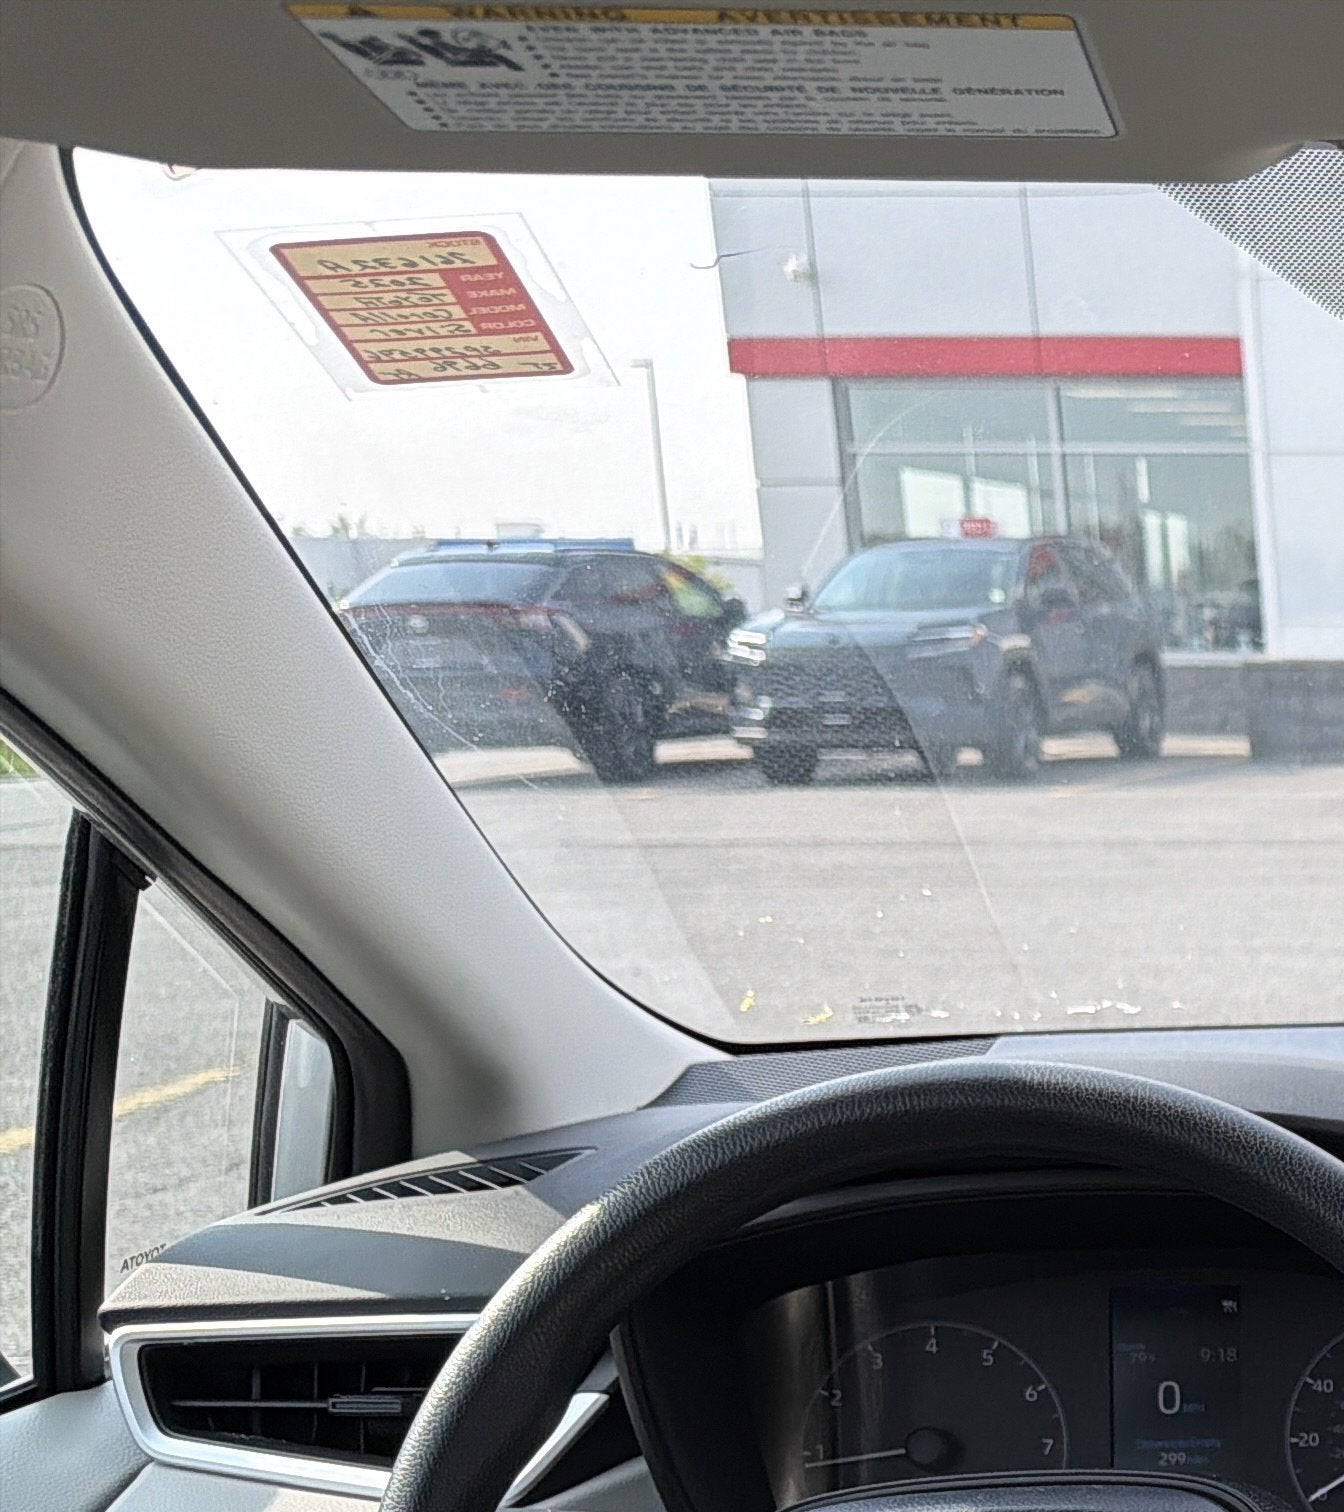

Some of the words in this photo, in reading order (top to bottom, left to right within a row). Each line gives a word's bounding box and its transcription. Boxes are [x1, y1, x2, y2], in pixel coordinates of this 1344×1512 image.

[925, 1338, 939, 1354] 4
[1200, 1347, 1239, 1362] 9:18
[872, 1352, 884, 1369] 3
[981, 1349, 994, 1366] 5
[1025, 1385, 1038, 1402] 6
[1313, 1379, 1334, 1393] 40
[829, 1390, 843, 1407] 2
[1157, 1380, 1182, 1415] 0
[1041, 1439, 1055, 1456] 7
[1298, 1433, 1320, 1447] 20
[1159, 1452, 1186, 1467] 299
